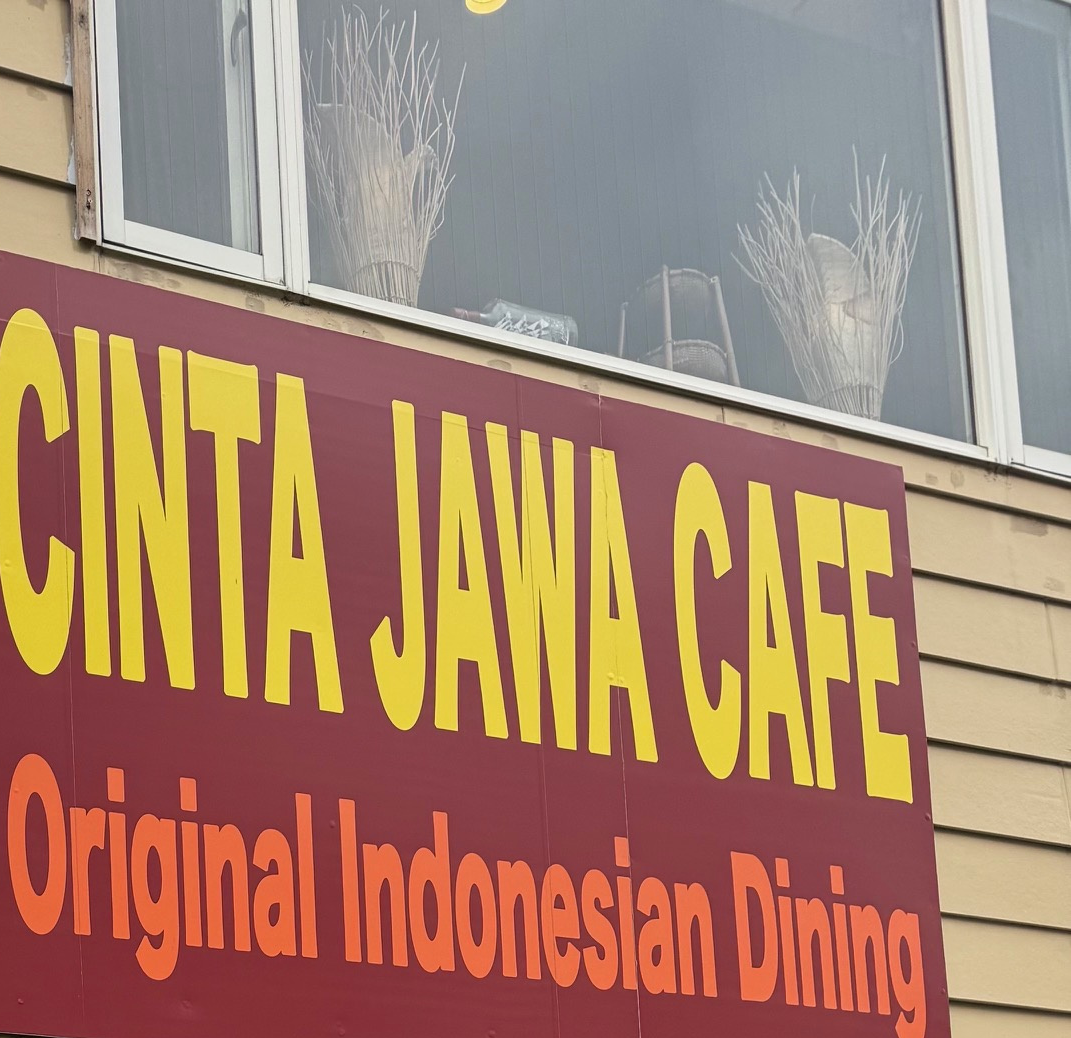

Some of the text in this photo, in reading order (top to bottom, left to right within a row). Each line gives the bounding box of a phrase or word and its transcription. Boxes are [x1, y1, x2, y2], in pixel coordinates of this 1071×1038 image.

[369, 398, 660, 764] JAWA
[673, 461, 913, 804] CAFE
[7, 751, 319, 981] Original
[338, 797, 718, 999] Indonesian
